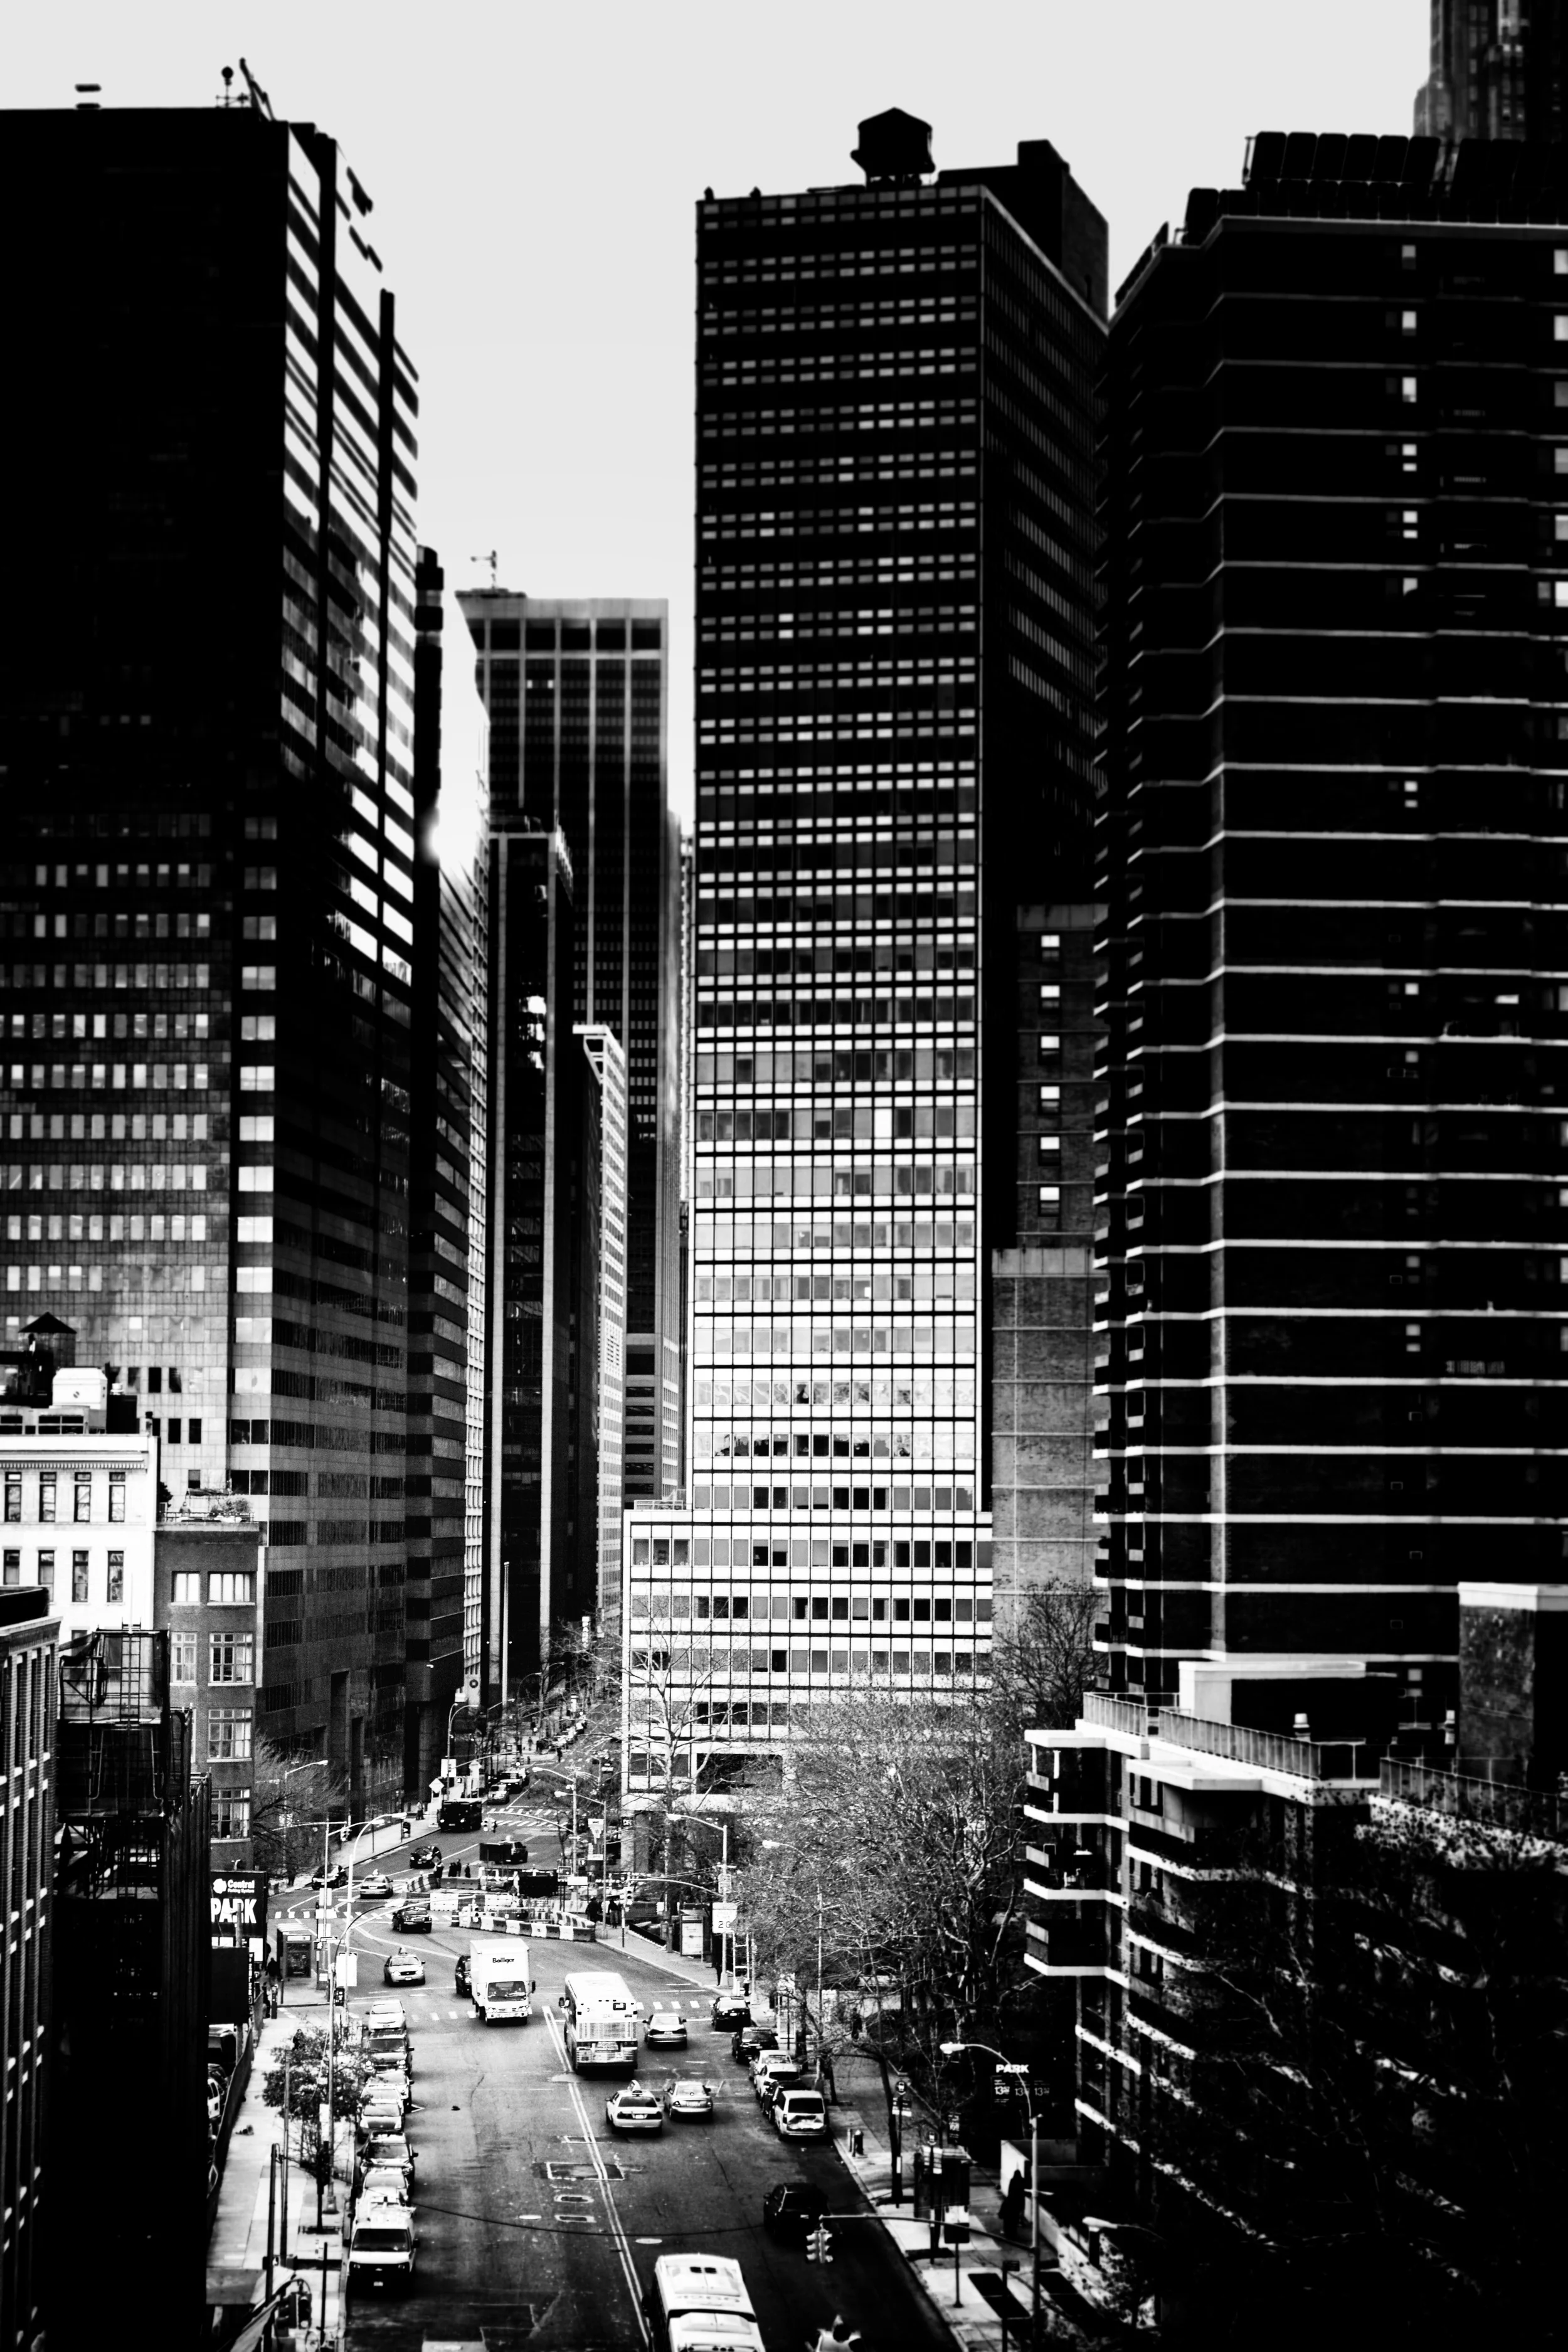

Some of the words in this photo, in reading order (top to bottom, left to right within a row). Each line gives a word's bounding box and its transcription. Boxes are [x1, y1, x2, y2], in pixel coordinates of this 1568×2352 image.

[227, 1879, 255, 1888] Central
[210, 1897, 257, 1924] PARK
[995, 2063, 1030, 2074] PARK
